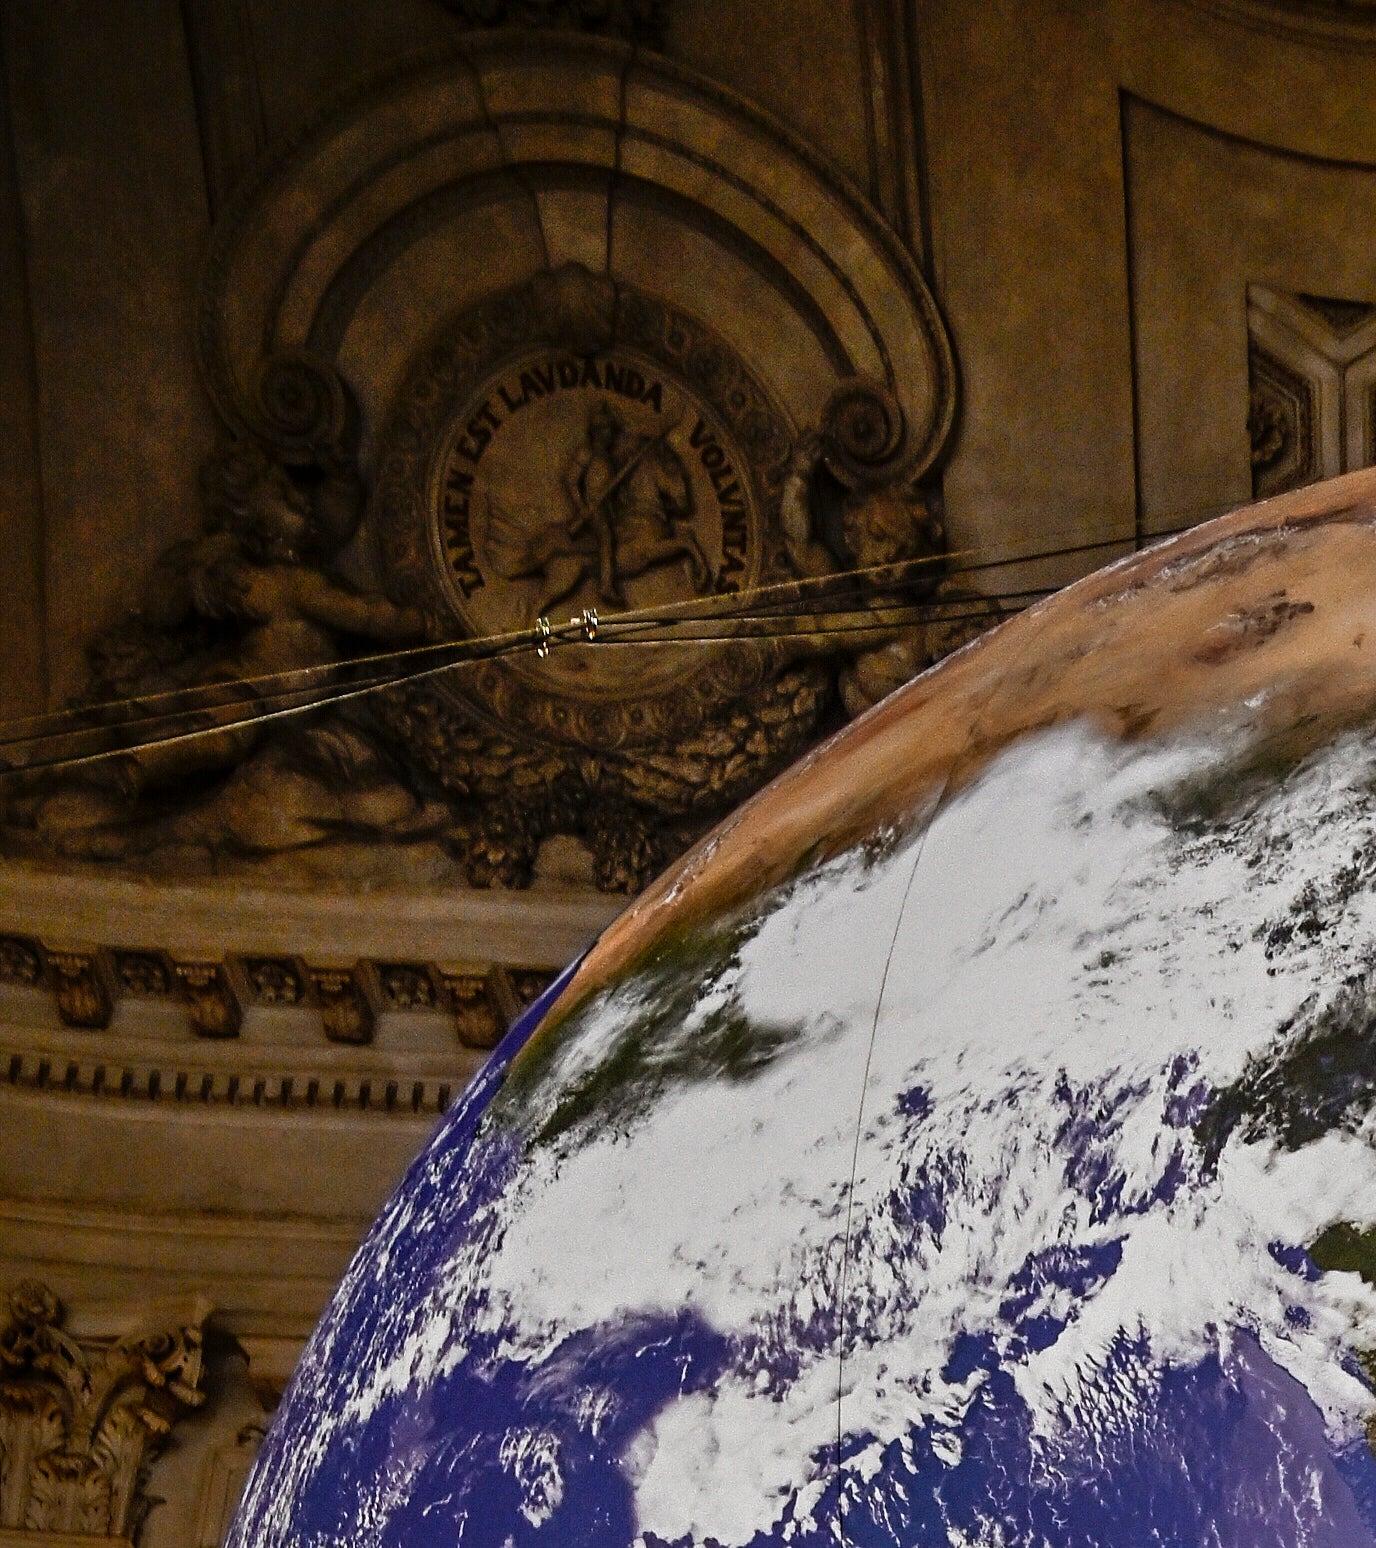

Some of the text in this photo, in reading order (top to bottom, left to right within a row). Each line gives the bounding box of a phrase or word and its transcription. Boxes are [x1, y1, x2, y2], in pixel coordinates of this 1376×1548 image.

[446, 356, 747, 597] TAMEN EST LAVDANDA VOLVNTAS
